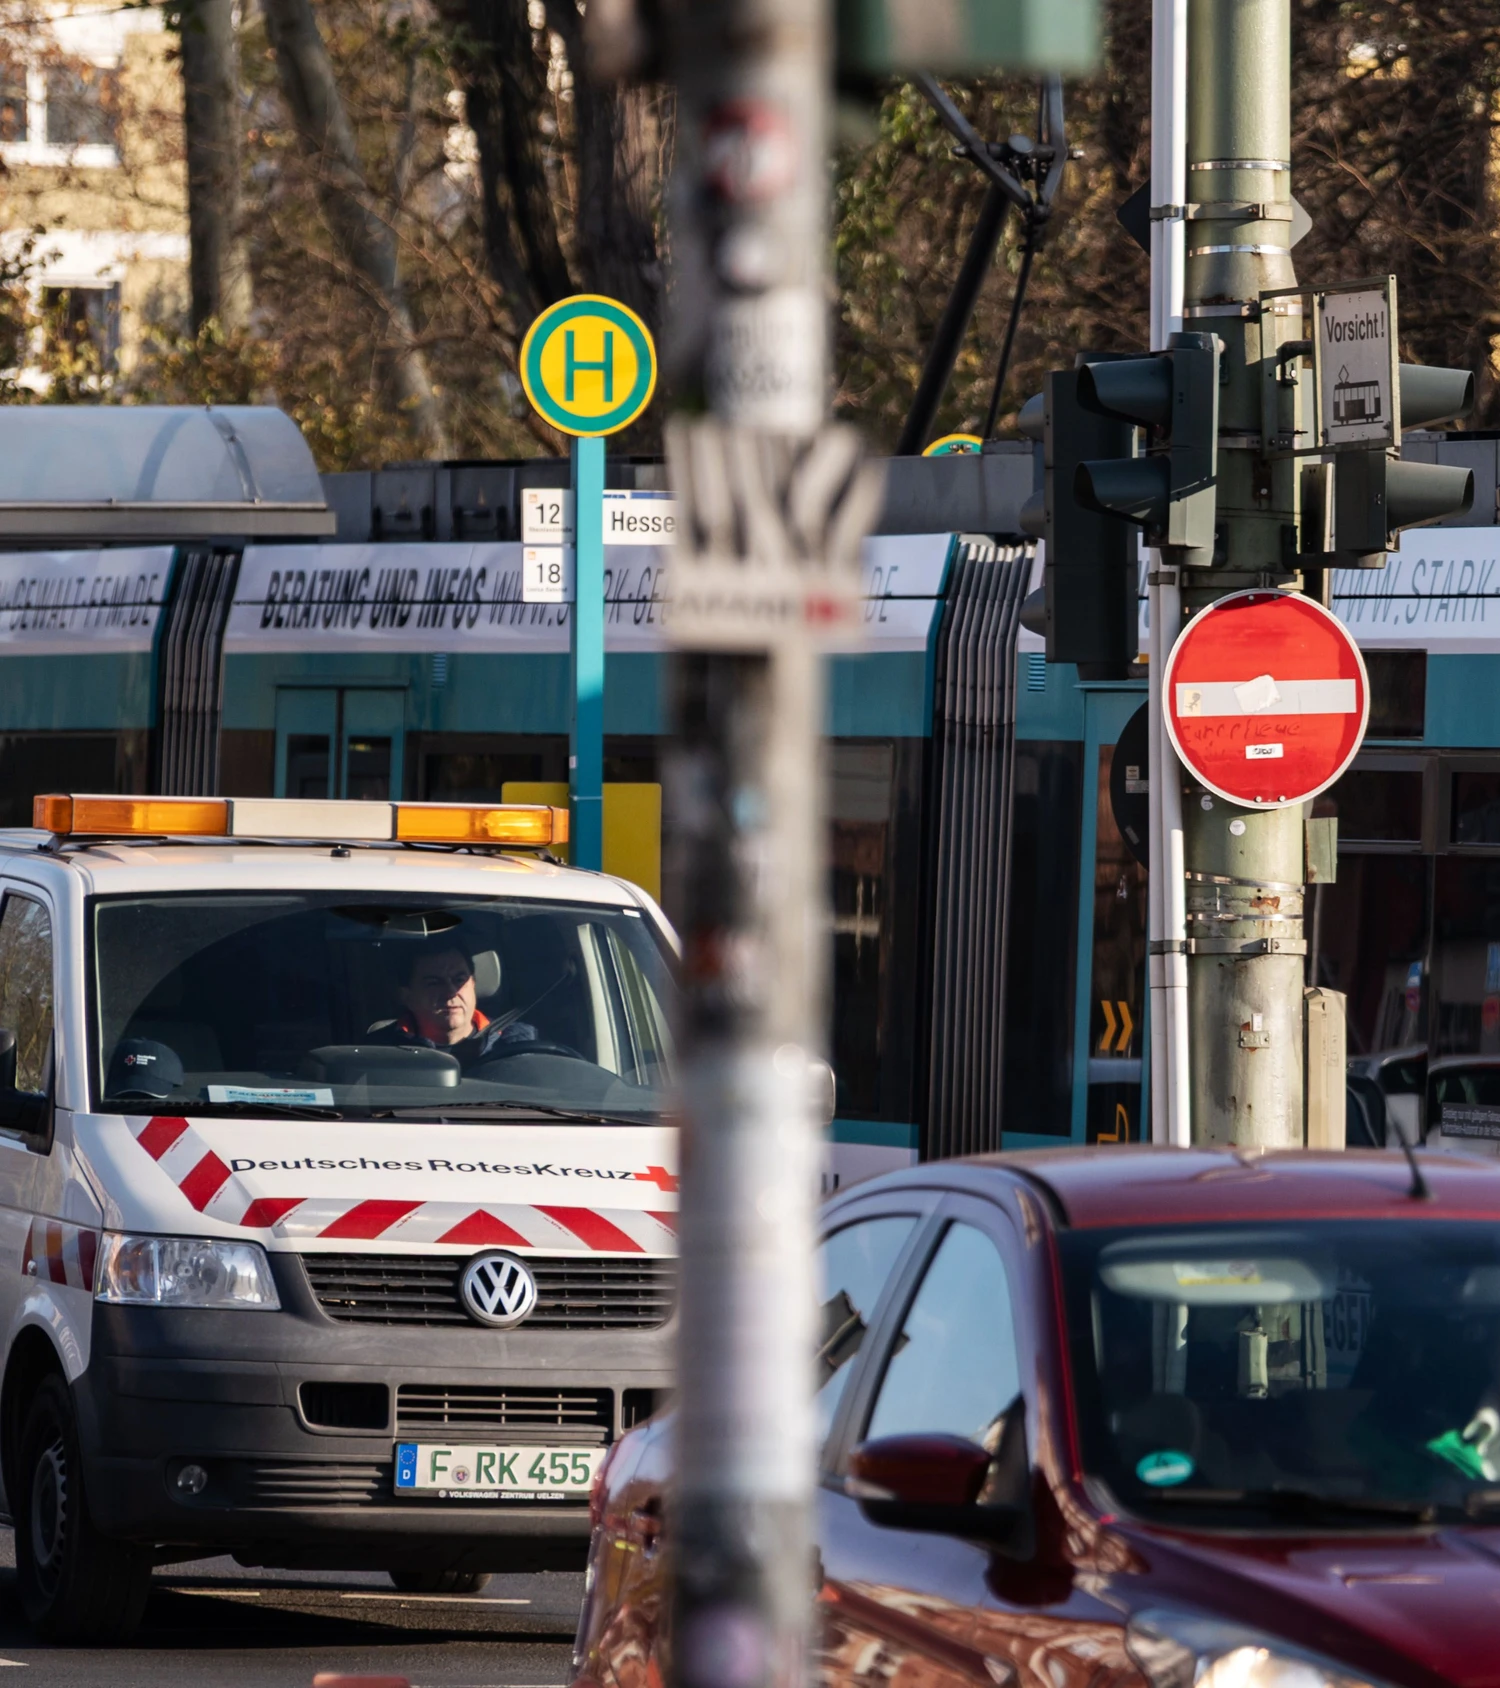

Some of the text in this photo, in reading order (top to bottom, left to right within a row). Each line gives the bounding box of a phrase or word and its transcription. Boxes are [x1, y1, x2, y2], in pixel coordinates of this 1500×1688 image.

[1325, 311, 1384, 342] Vorsicht!
[564, 330, 613, 403] H
[535, 503, 560, 525] 12
[536, 562, 561, 584] 18
[259, 567, 371, 630] BERATUNG
[369, 568, 419, 630] UND
[416, 566, 487, 630] INFOS
[230, 1157, 422, 1172] Deutsches
[402, 1469, 411, 1480] D
[430, 1450, 591, 1485] F RK 455
[449, 1491, 565, 1500] VOLKSWAGEN ZENTRUM UELZEN
